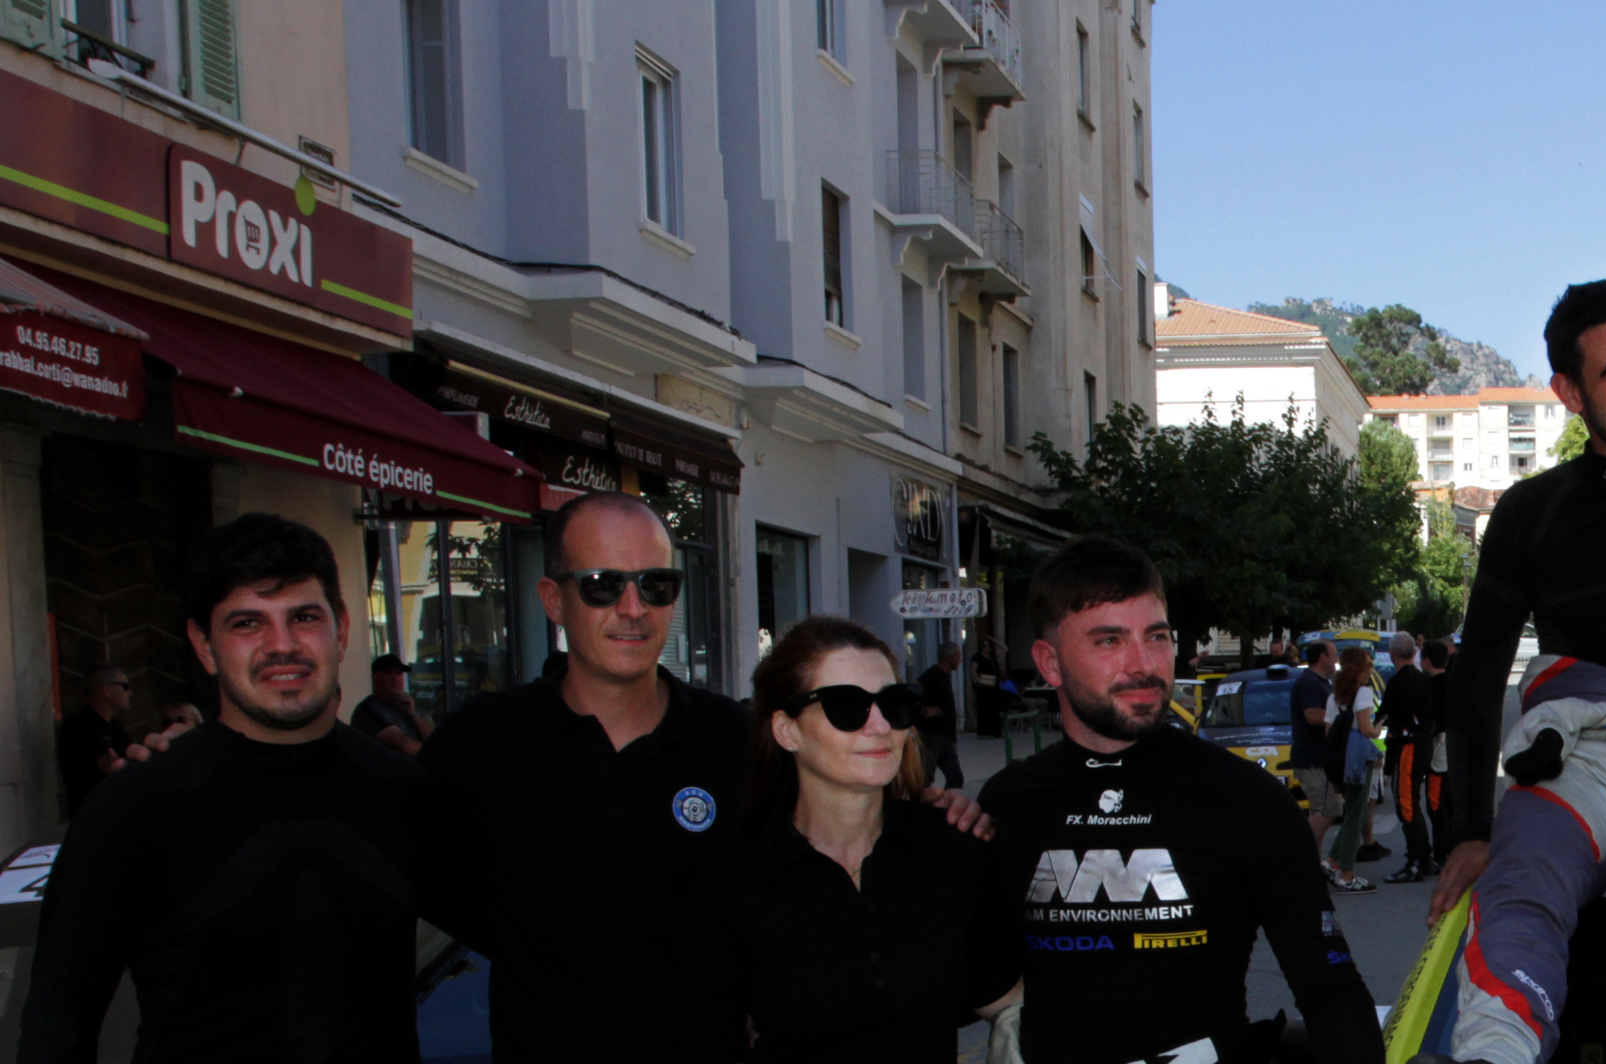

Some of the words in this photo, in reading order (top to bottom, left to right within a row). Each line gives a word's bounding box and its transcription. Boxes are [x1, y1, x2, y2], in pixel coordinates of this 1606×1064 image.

[323, 442, 366, 478] Côté
[368, 453, 434, 495] épicerie
[1066, 815, 1084, 825] FX.
[1087, 814, 1152, 825] Moracchini
[1050, 904, 1194, 922] ENVIRONNEMENT
[1133, 929, 1208, 949] PIRELLI
